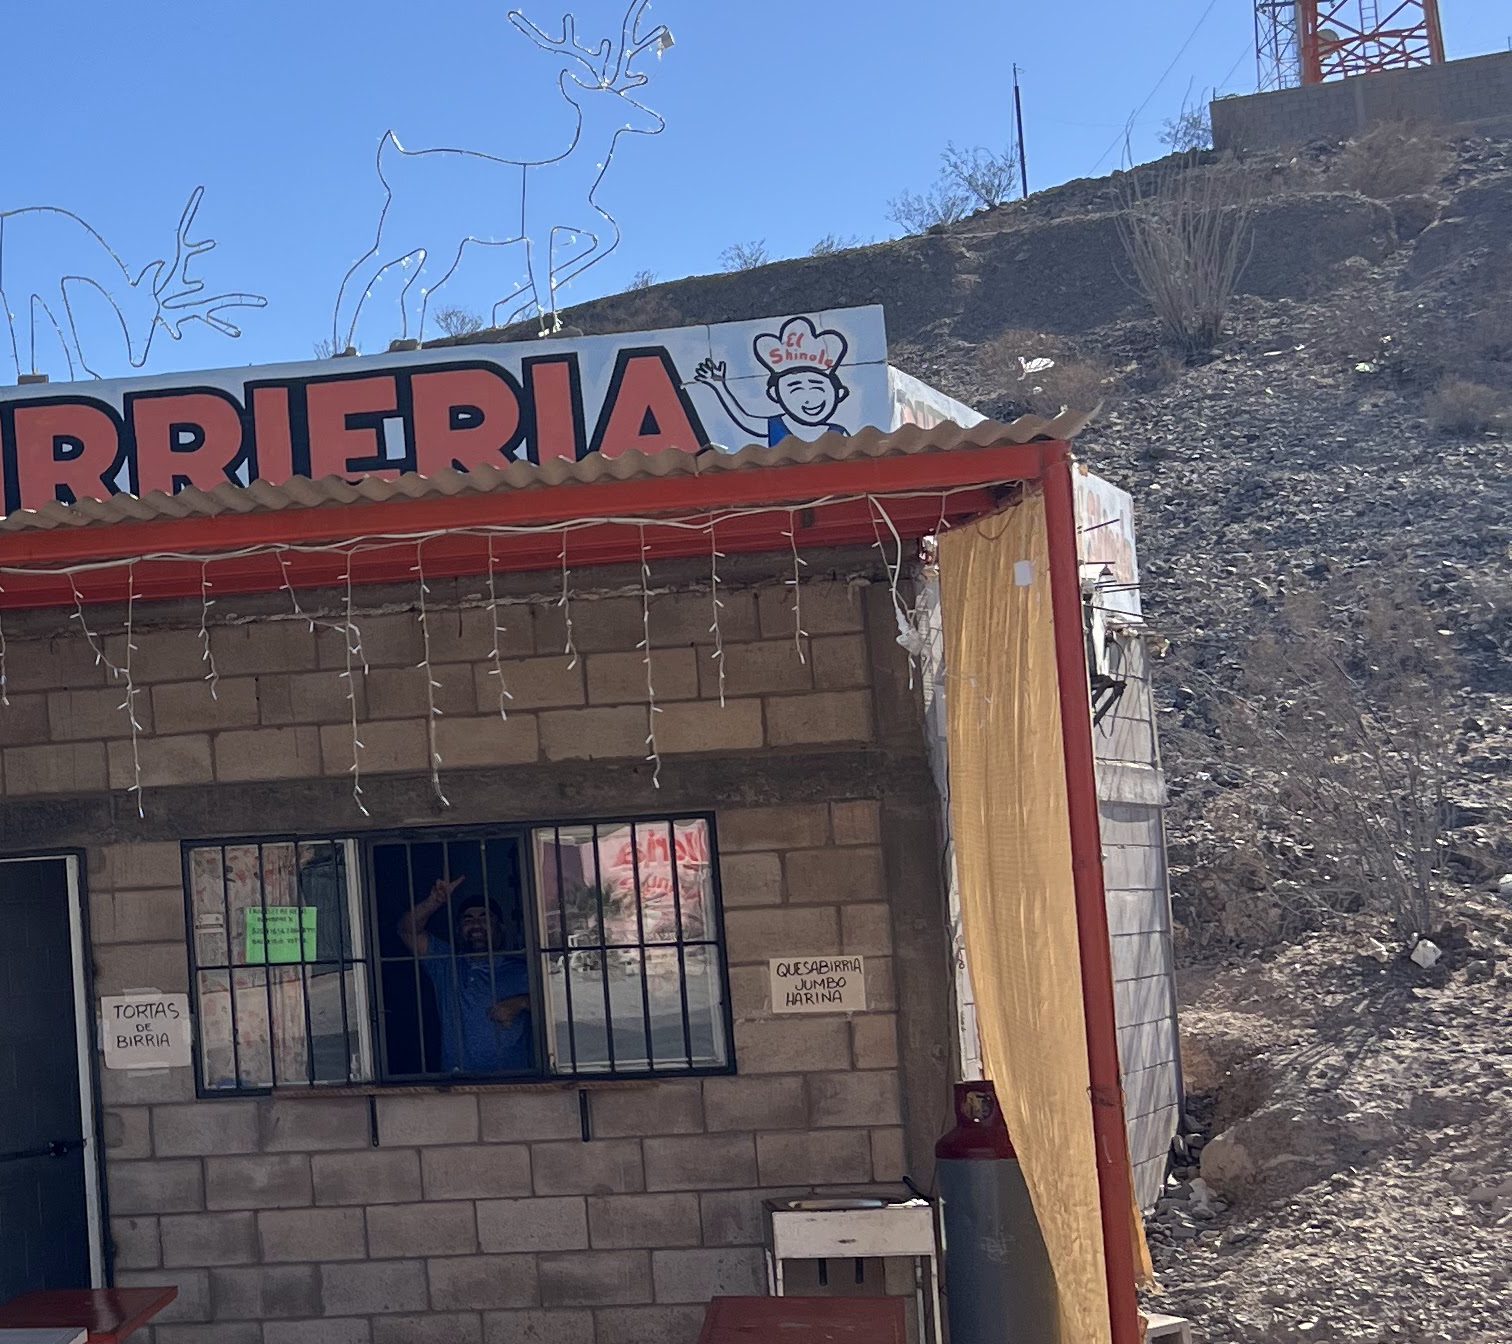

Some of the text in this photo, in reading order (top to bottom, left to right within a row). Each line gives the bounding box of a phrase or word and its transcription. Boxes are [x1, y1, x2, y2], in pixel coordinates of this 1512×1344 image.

[786, 332, 804, 348] El
[776, 958, 863, 977] QUESABIRRIA
[794, 977, 847, 991] JUMBO
[785, 989, 843, 1006] HARINA
[113, 1002, 180, 1019] TORTAS
[136, 1023, 153, 1032] DE
[116, 1032, 170, 1049] BIRRIA
